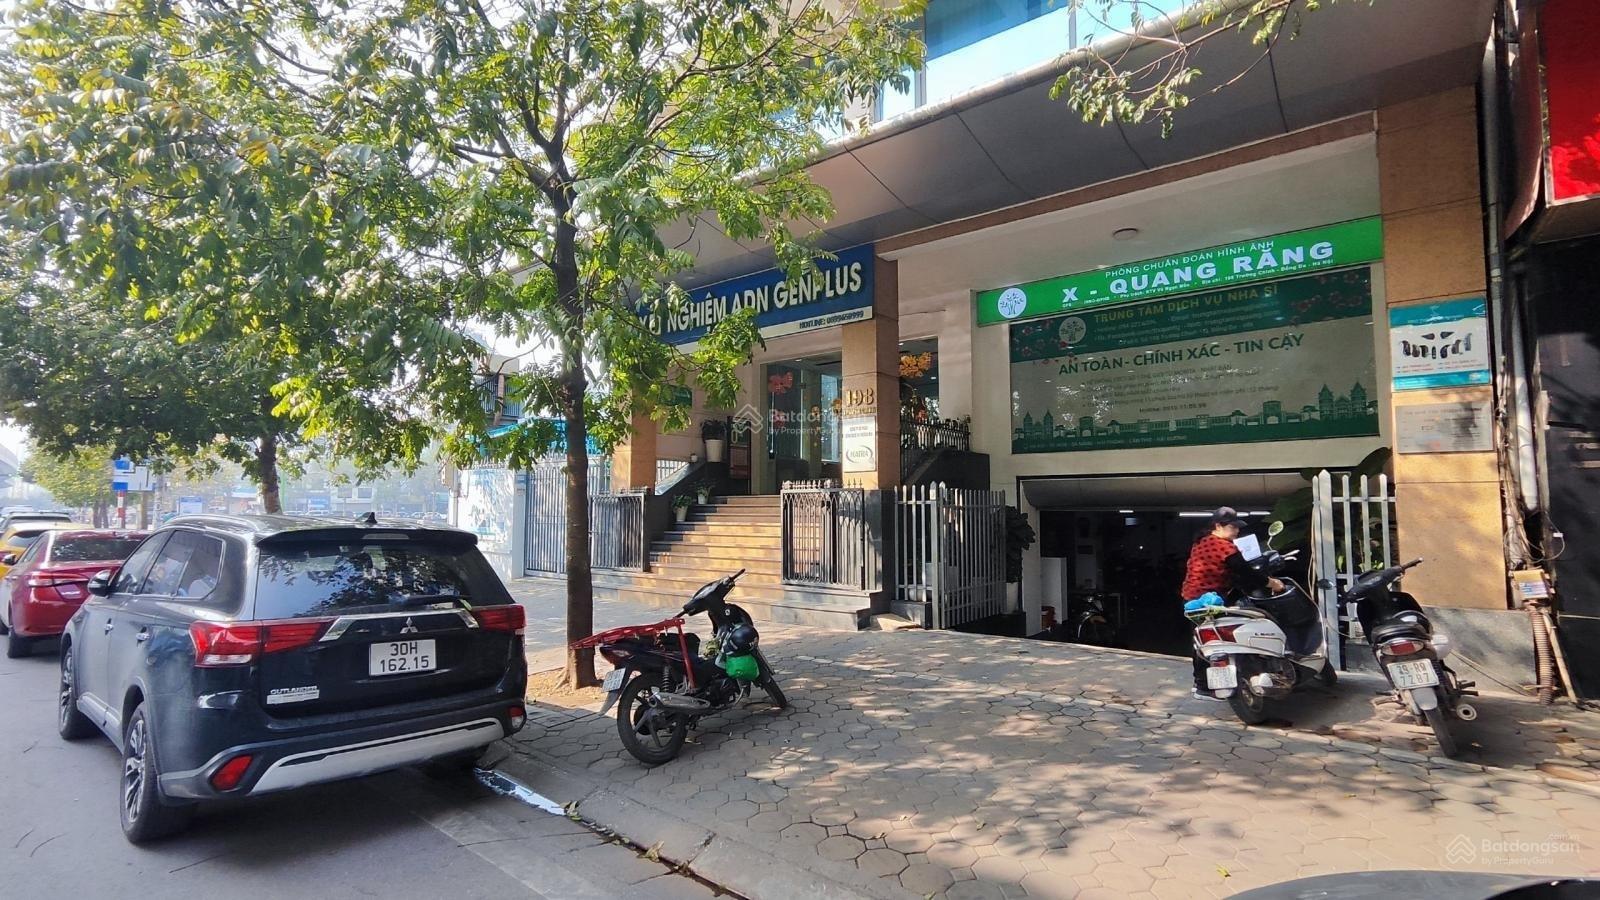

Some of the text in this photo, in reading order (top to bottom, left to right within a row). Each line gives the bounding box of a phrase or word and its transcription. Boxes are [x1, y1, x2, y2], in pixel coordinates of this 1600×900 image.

[1062, 287, 1079, 302] X
[1109, 262, 1217, 294] QUANG
[1233, 241, 1334, 274] RĂNG
[667, 292, 727, 333] NGHIỆM
[730, 284, 769, 315] ADN
[1094, 309, 1134, 323] TRUNG
[1167, 298, 1200, 313] DỊCH
[1226, 287, 1259, 302] NHA
[1059, 363, 1079, 375] AN
[1133, 350, 1183, 366] CHÍNH
[1186, 344, 1220, 362] XÁC
[1233, 341, 1264, 354] TIN
[1268, 333, 1305, 350] CẬY
[845, 387, 875, 408] 198
[380, 655, 430, 673] 162.15
[390, 642, 418, 656] 30H
